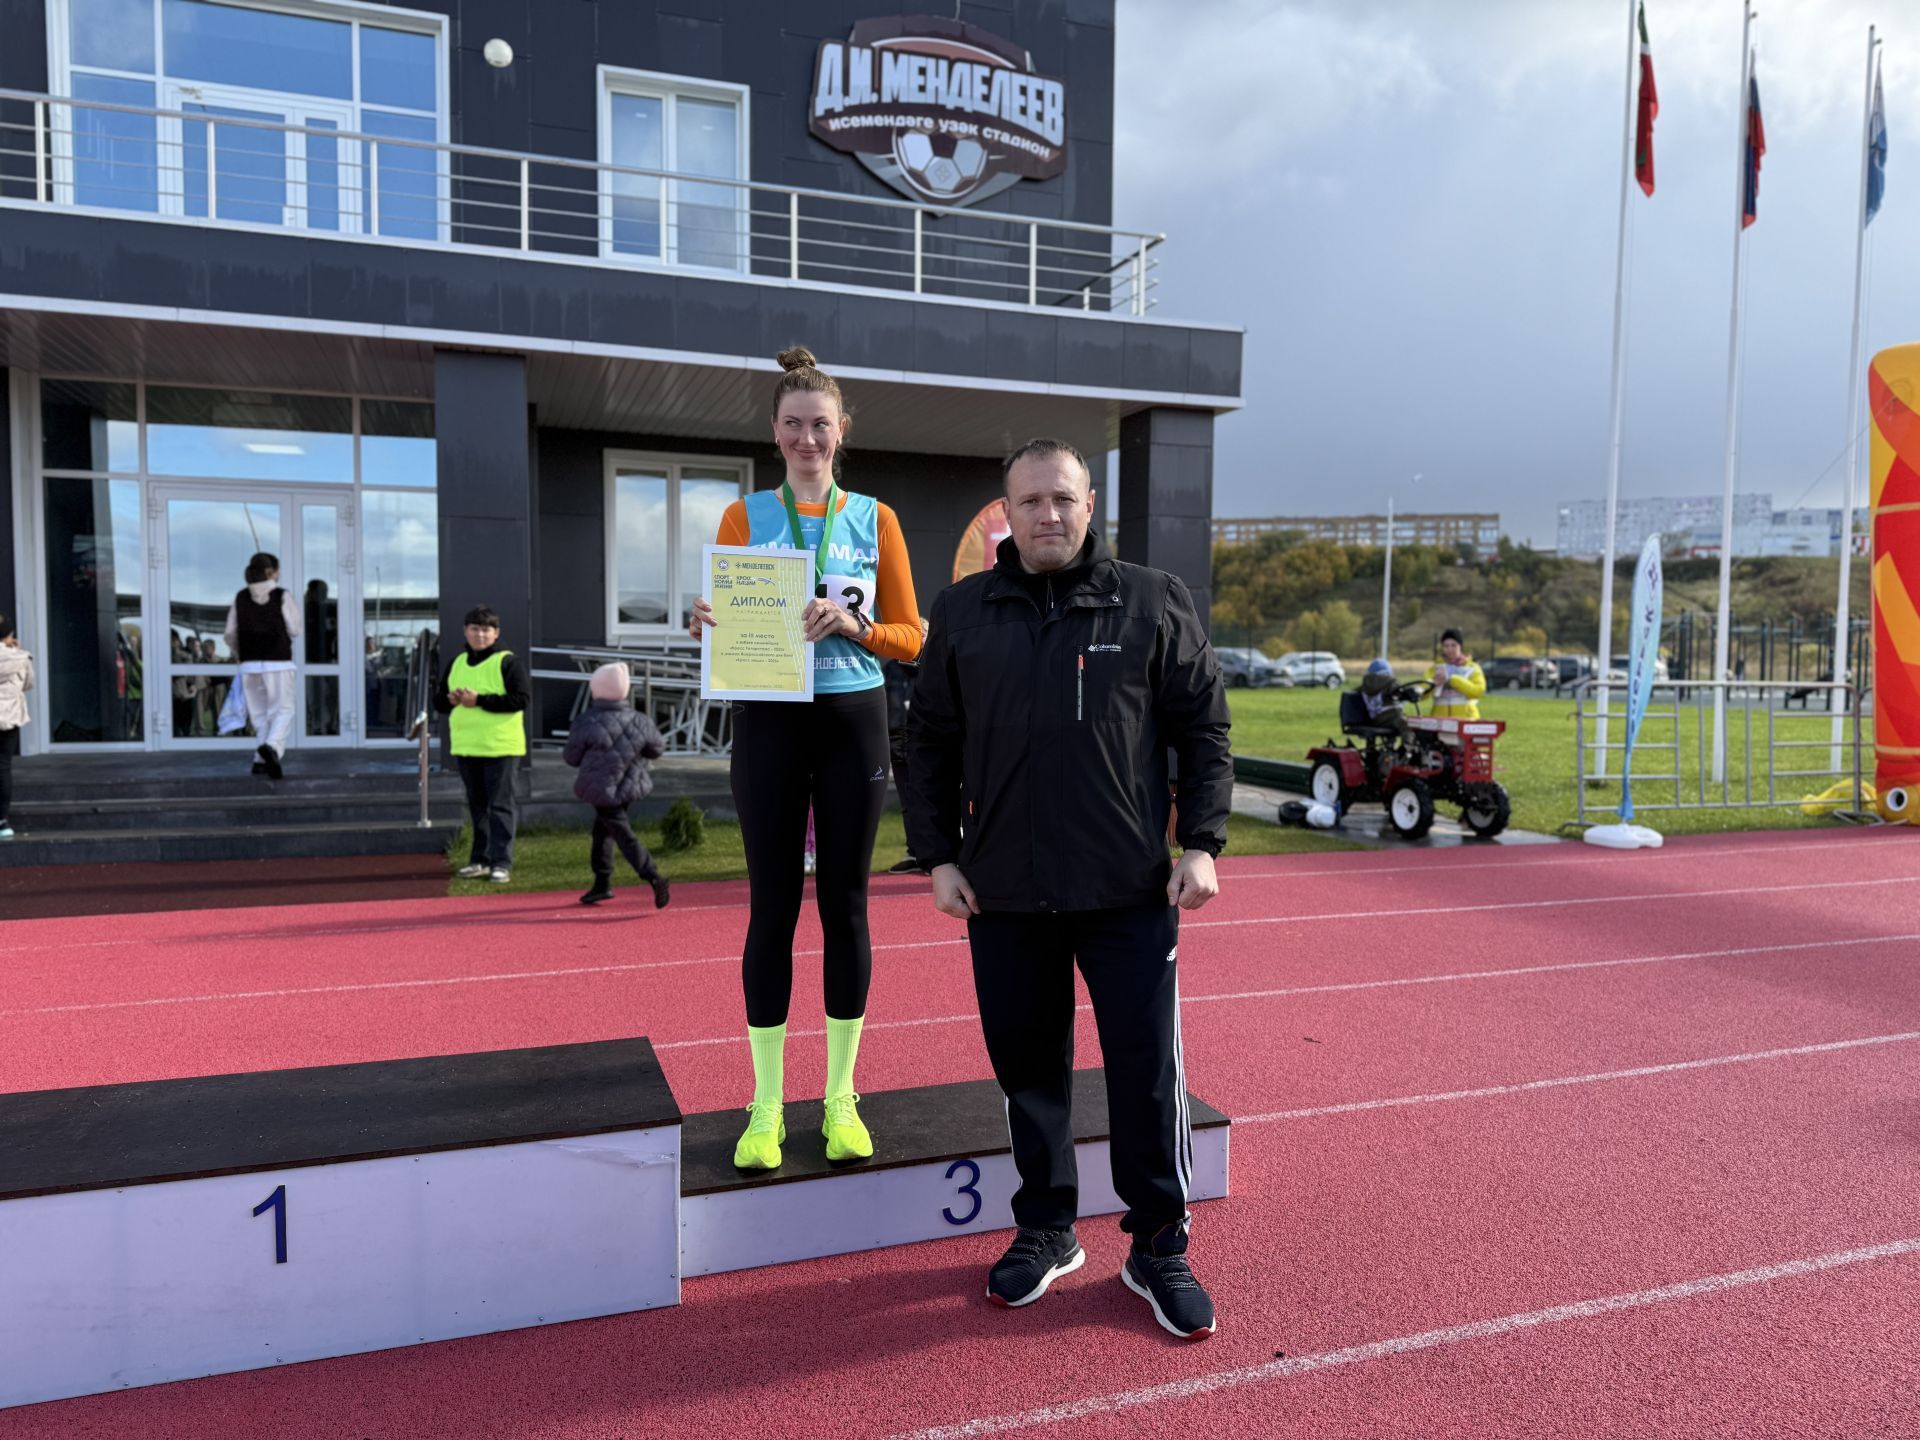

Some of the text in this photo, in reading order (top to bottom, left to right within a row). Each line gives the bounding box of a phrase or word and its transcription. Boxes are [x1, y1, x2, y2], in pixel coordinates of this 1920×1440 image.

[881, 50, 1064, 147] МЕНДЕЛЕЕВ
[982, 126, 1051, 159] стадион
[730, 595, 787, 608] ДИПЛОМ
[253, 1184, 288, 1264] 1
[942, 1159, 982, 1226] 3
